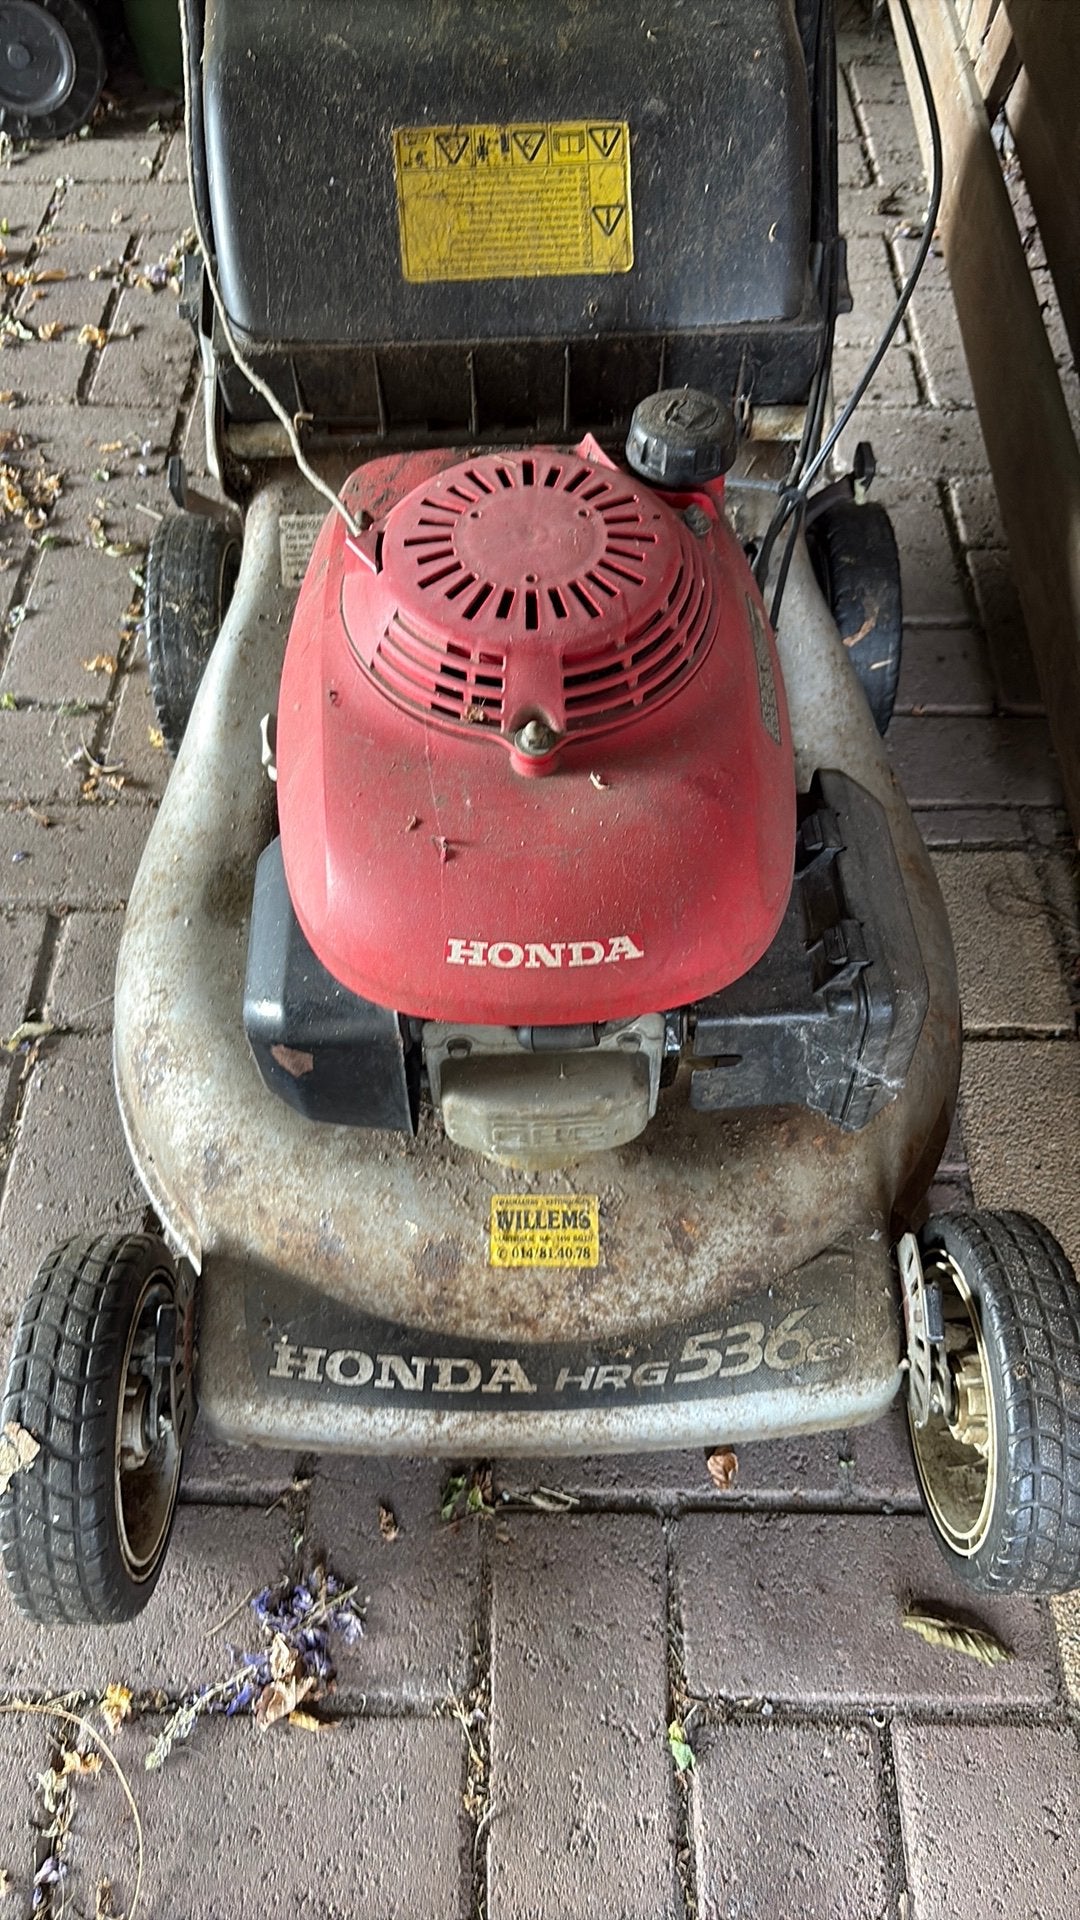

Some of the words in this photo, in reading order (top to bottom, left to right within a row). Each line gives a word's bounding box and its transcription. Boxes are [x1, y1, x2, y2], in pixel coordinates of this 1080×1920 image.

[446, 935, 644, 968] HONDA
[496, 1209, 591, 1231] WILLEMS
[268, 1341, 537, 1394] HONDA
[555, 1361, 670, 1392] HRG
